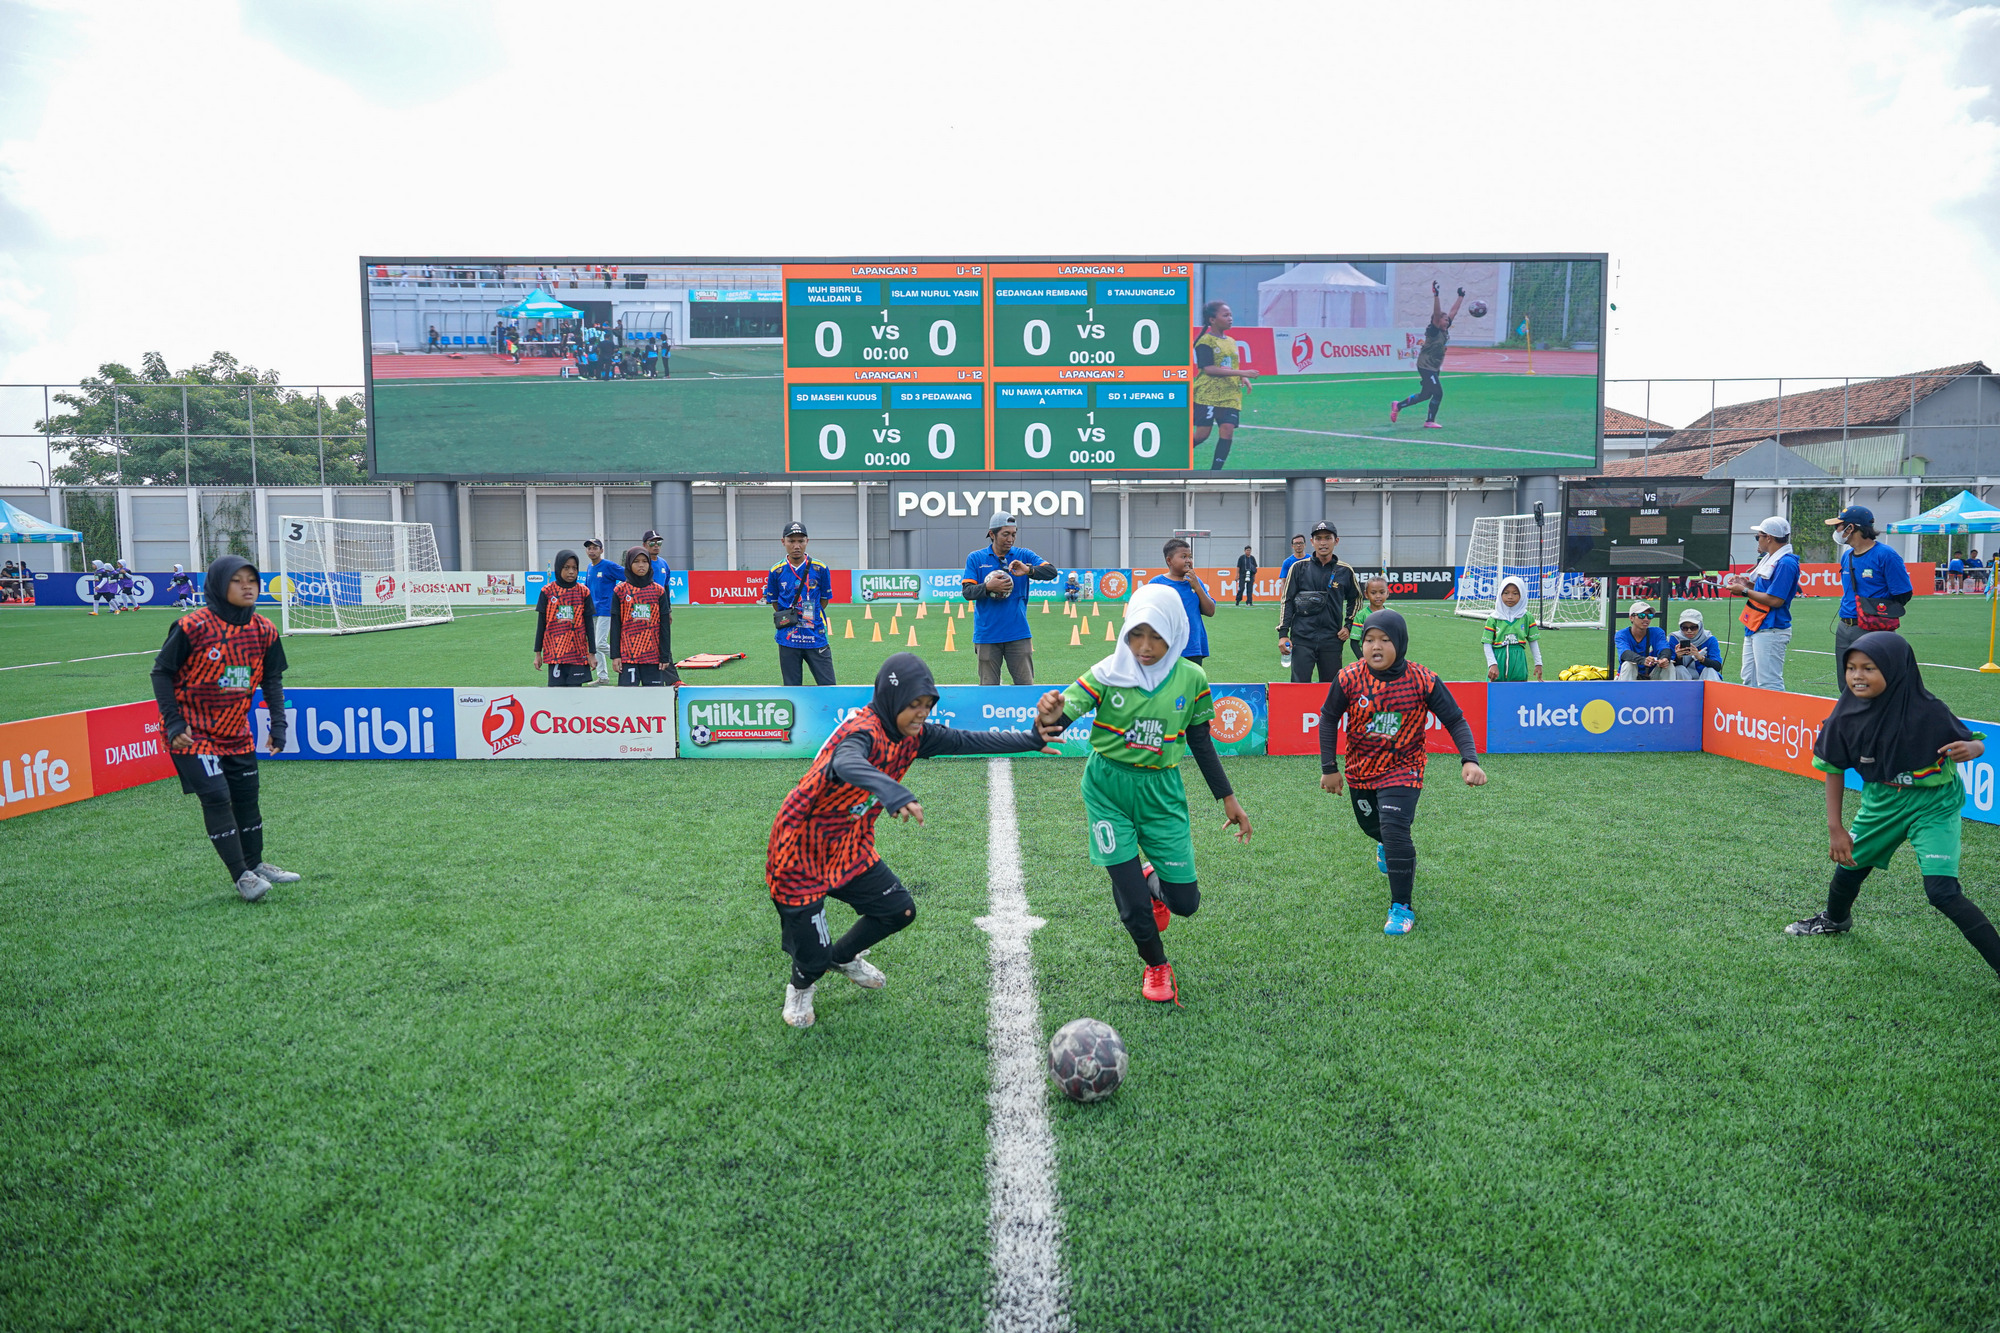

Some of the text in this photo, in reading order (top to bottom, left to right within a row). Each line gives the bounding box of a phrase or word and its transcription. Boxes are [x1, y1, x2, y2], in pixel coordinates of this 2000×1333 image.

[852, 266, 918, 275] LAPANGAN 3
[956, 266, 982, 275] U-12
[1058, 266, 1124, 275] LAPANGAN 4
[1162, 265, 1188, 274] U-12
[807, 286, 862, 294] MUH BIRRUL
[891, 290, 919, 298] ISLAM
[996, 289, 1088, 297] GEDANGAN REMBANG
[1107, 289, 1175, 297] 8 TANJUNGREJO
[880, 309, 889, 323] 1
[1085, 308, 1094, 322] 1
[871, 325, 900, 340] VS
[928, 319, 957, 357] 0
[1023, 319, 1051, 356] 0
[1076, 324, 1106, 339] VS
[1132, 318, 1160, 355] 0
[814, 320, 843, 358] 0
[863, 347, 909, 360] 00:00
[1320, 341, 1392, 358] CROISSANT
[1069, 351, 1115, 364] 00:00
[854, 371, 918, 380] LAPANGAN 1
[957, 371, 983, 380] U-12
[1059, 370, 1125, 379] LAPANGAN 2
[1163, 370, 1188, 379] U-12
[901, 393, 913, 401] SD
[1044, 388, 1083, 396] KARTIKA
[1168, 392, 1175, 400] B
[1039, 397, 1046, 405] A
[882, 412, 890, 426] 1
[1086, 411, 1095, 425] 1
[818, 423, 847, 460] 0
[872, 428, 901, 443] VS
[927, 423, 956, 459] 0
[1024, 422, 1052, 459] 0
[1077, 427, 1106, 442] VS
[1133, 422, 1161, 458] 0
[864, 453, 911, 466] 00:00
[1069, 450, 1115, 463] 00:00
[898, 490, 1085, 517] POLYTRON
[1645, 493, 1657, 501] VS
[288, 523, 304, 541] 3
[862, 576, 918, 590] MilkLife
[1403, 571, 1452, 582] BENAR
[710, 587, 758, 598] DJARUM
[1029, 589, 1057, 597] aktosa
[227, 667, 250, 678] Milk
[552, 664, 560, 678] 6
[230, 677, 250, 688] Life
[691, 702, 790, 726] MilkLife
[1214, 700, 1248, 714] INDONESIA
[490, 694, 515, 742] 5
[530, 710, 667, 734] CROISSANT
[1375, 713, 1399, 726] Milk
[1517, 703, 1674, 727] tiket com
[306, 707, 435, 754] blibli
[1135, 719, 1163, 734] Milk
[1211, 724, 1248, 738] LACTOSE FREE
[1375, 723, 1399, 736] Life
[493, 735, 522, 754] DAYS
[1136, 731, 1162, 747] Life
[105, 739, 158, 765] DJARUM
[197, 754, 223, 777] 12
[0, 749, 71, 807] Life
[1357, 799, 1372, 817] 9
[1092, 820, 1116, 854] 10
